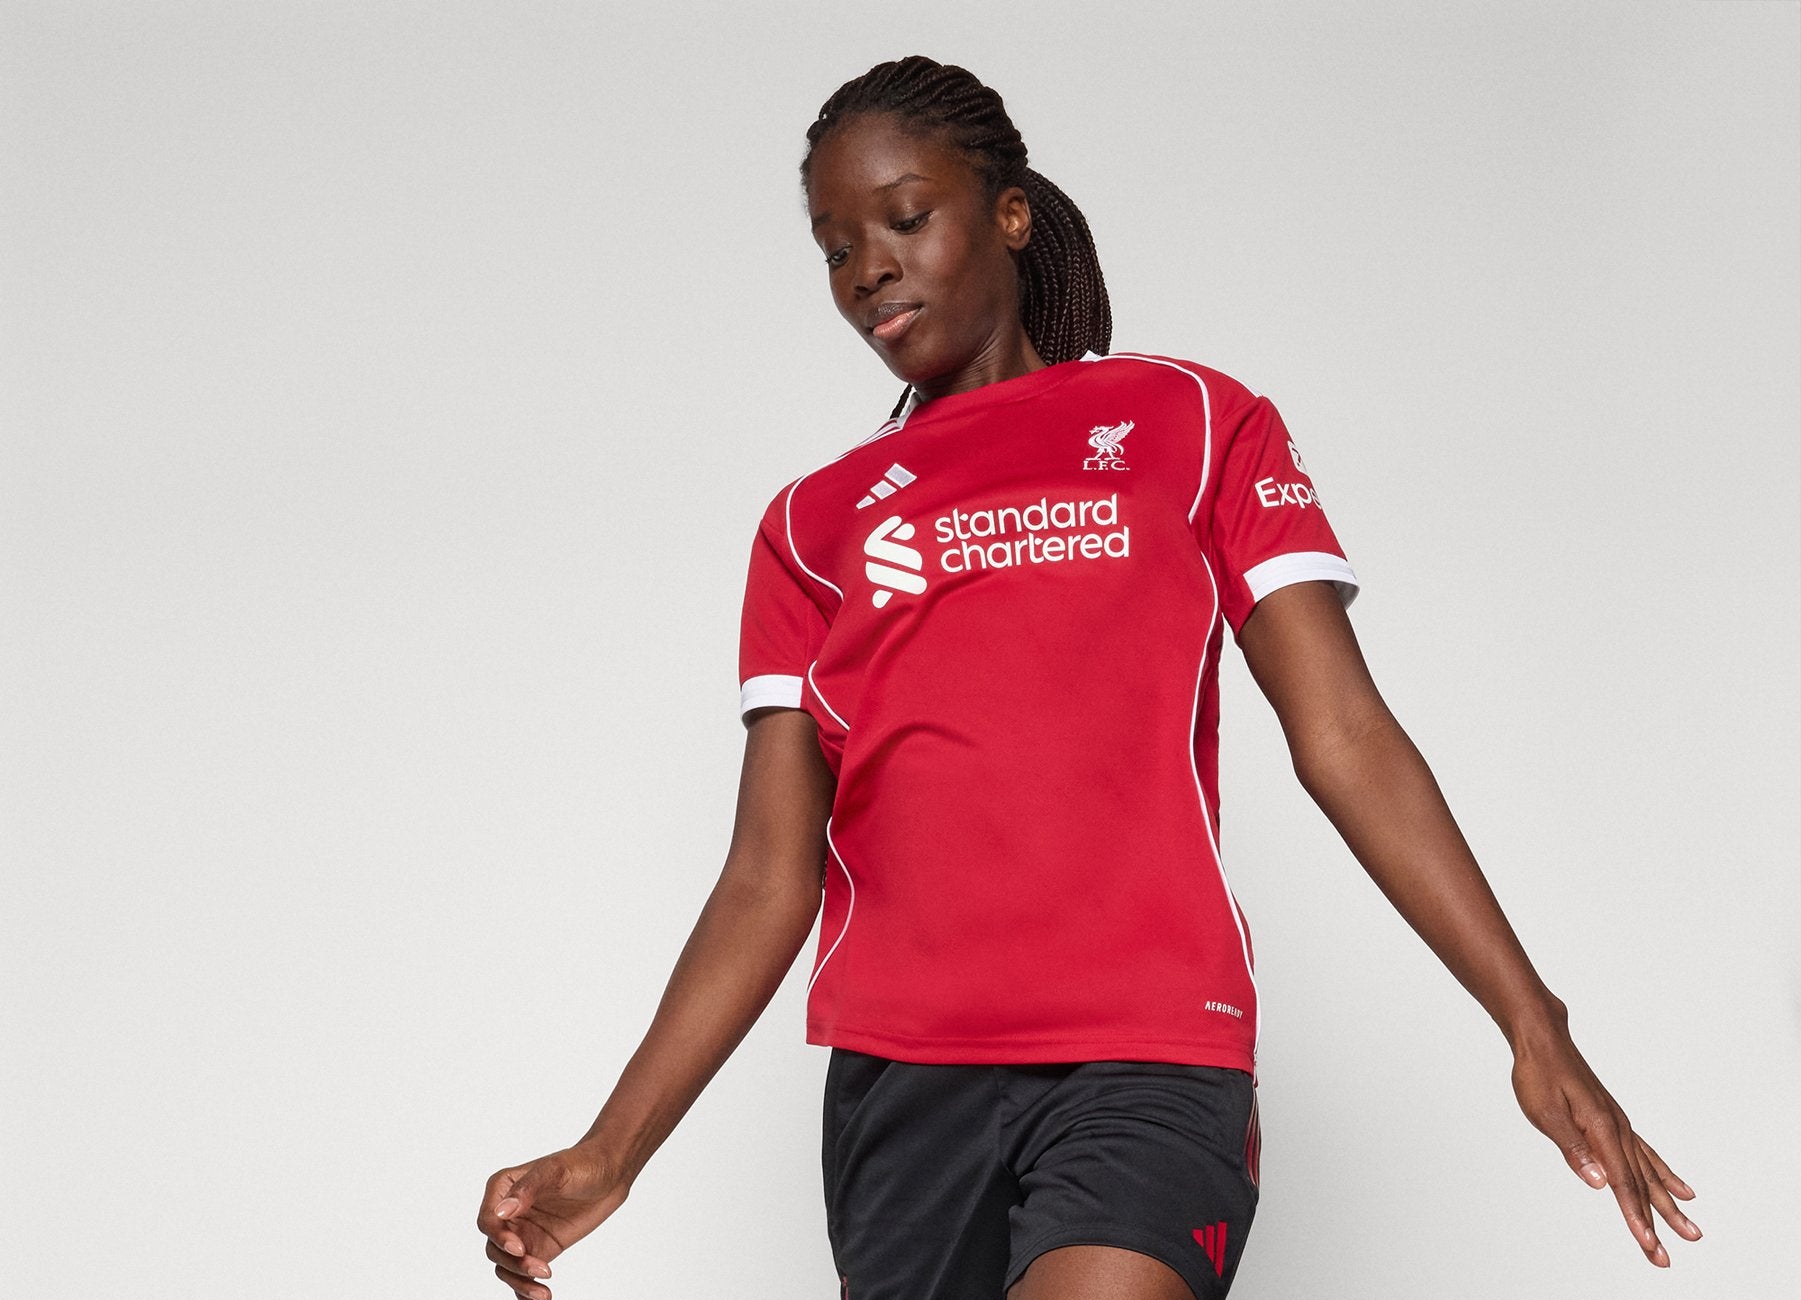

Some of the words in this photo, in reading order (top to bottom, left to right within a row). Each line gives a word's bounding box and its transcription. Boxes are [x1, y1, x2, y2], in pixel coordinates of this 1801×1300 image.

[934, 493, 1117, 543] standard
[940, 525, 1129, 573] chartered
[1205, 1001, 1243, 1019] AEROREADY
